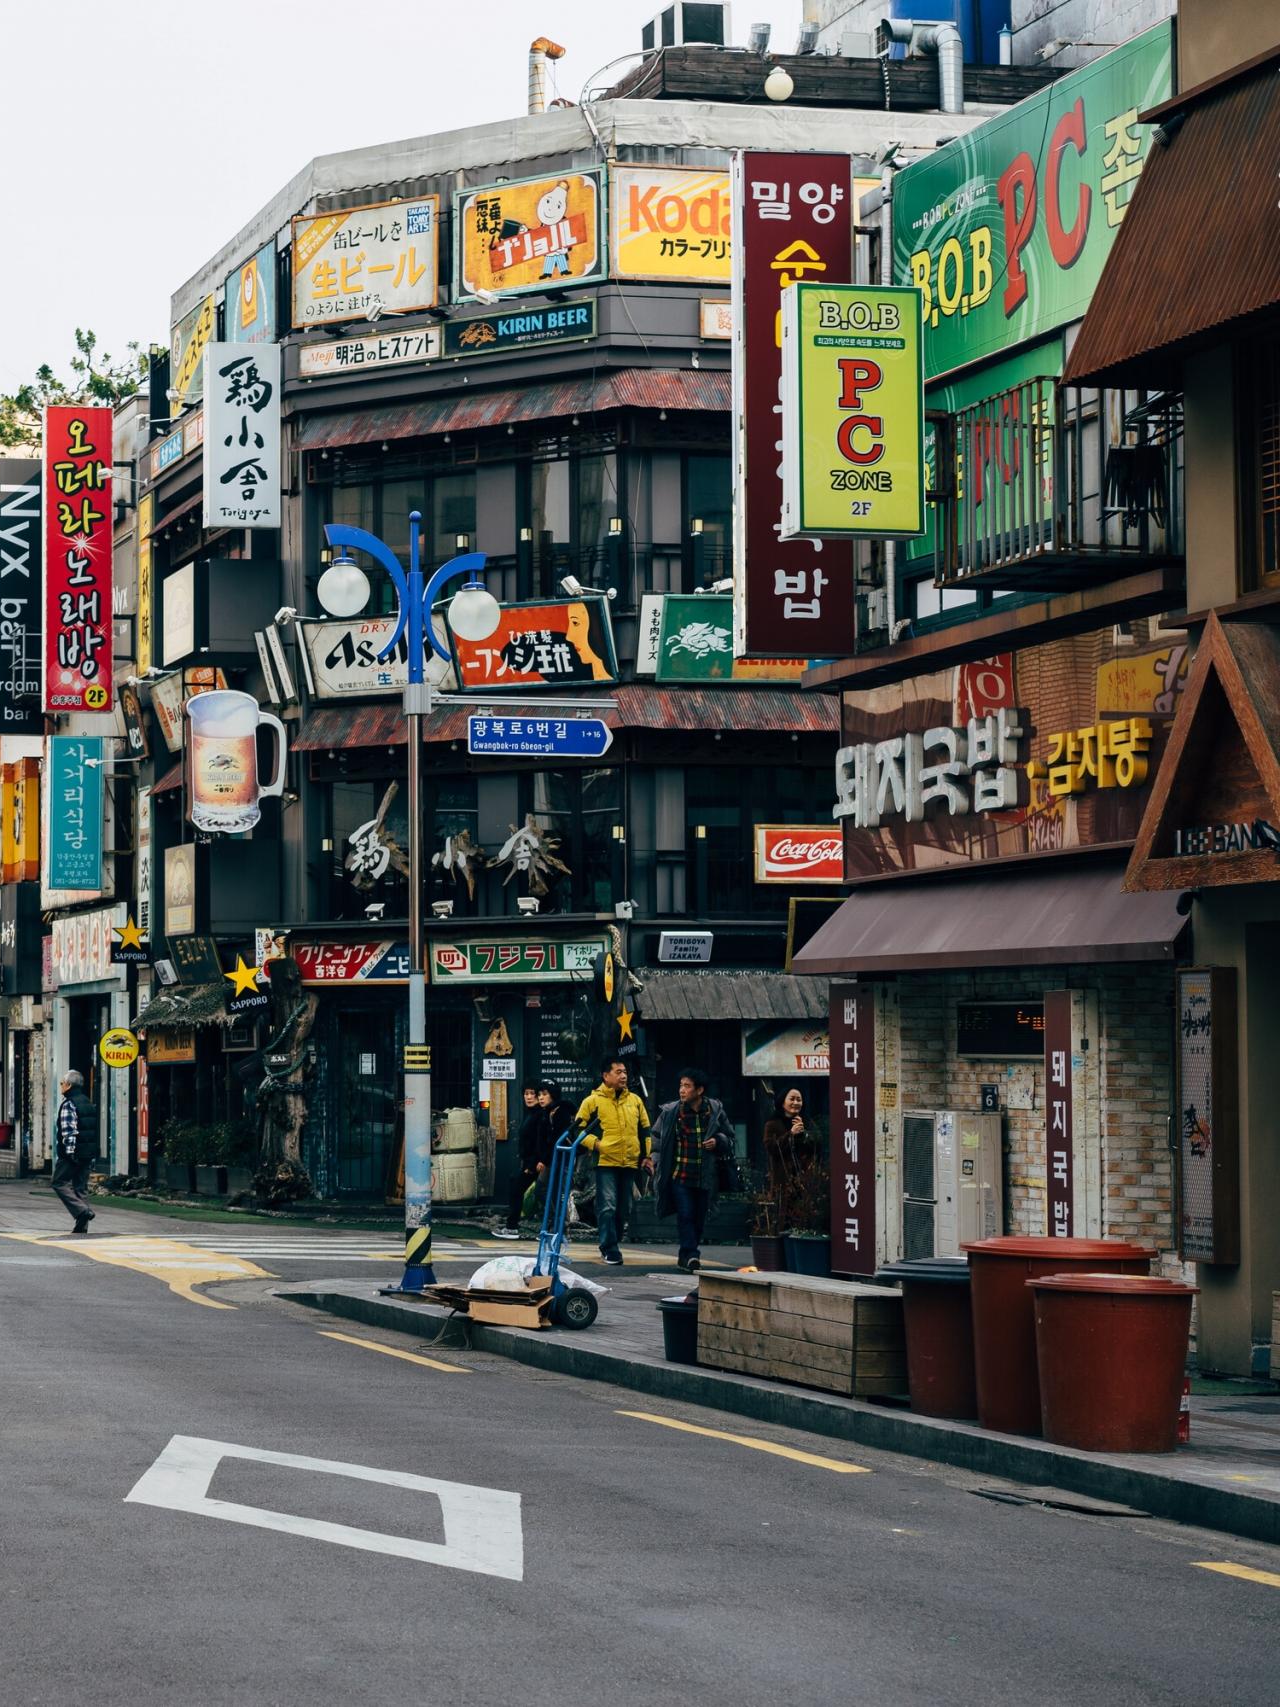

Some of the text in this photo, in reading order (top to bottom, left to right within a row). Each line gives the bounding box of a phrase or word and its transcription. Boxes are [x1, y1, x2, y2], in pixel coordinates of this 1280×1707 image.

[750, 180, 844, 225] 밀양
[996, 96, 1092, 319] PC
[1101, 107, 1145, 229] 존
[407, 214, 430, 225] TOMY
[333, 220, 402, 250] 缶ビールを
[407, 222, 430, 235] ARTS
[311, 246, 427, 300] 生ビール
[497, 314, 543, 336] KIRIN
[547, 307, 588, 329] BEER
[820, 301, 900, 331] B.O.B
[830, 470, 893, 493] ZONE
[851, 501, 872, 516] 2F
[51, 420, 104, 680] 오페라 노래방
[360, 623, 390, 635] DRY
[88, 689, 104, 703] 2F
[3, 706, 30, 722] bar
[473, 740, 554, 752] Gwangbok-ro 6beon-gil
[833, 707, 1154, 829] 돼지국밥 감자탕
[669, 937, 707, 945] TORIGOYA
[114, 952, 147, 960] SAPPORO
[669, 953, 702, 961] IZAKAYA
[673, 945, 699, 954] Family
[230, 995, 268, 1011] SAPPORO
[105, 1051, 133, 1061] KIRIN
[985, 1094, 993, 1107] 6
[843, 998, 860, 1251] 뼈다귀해장국
[1051, 1050, 1068, 1238] 돼지국밥
